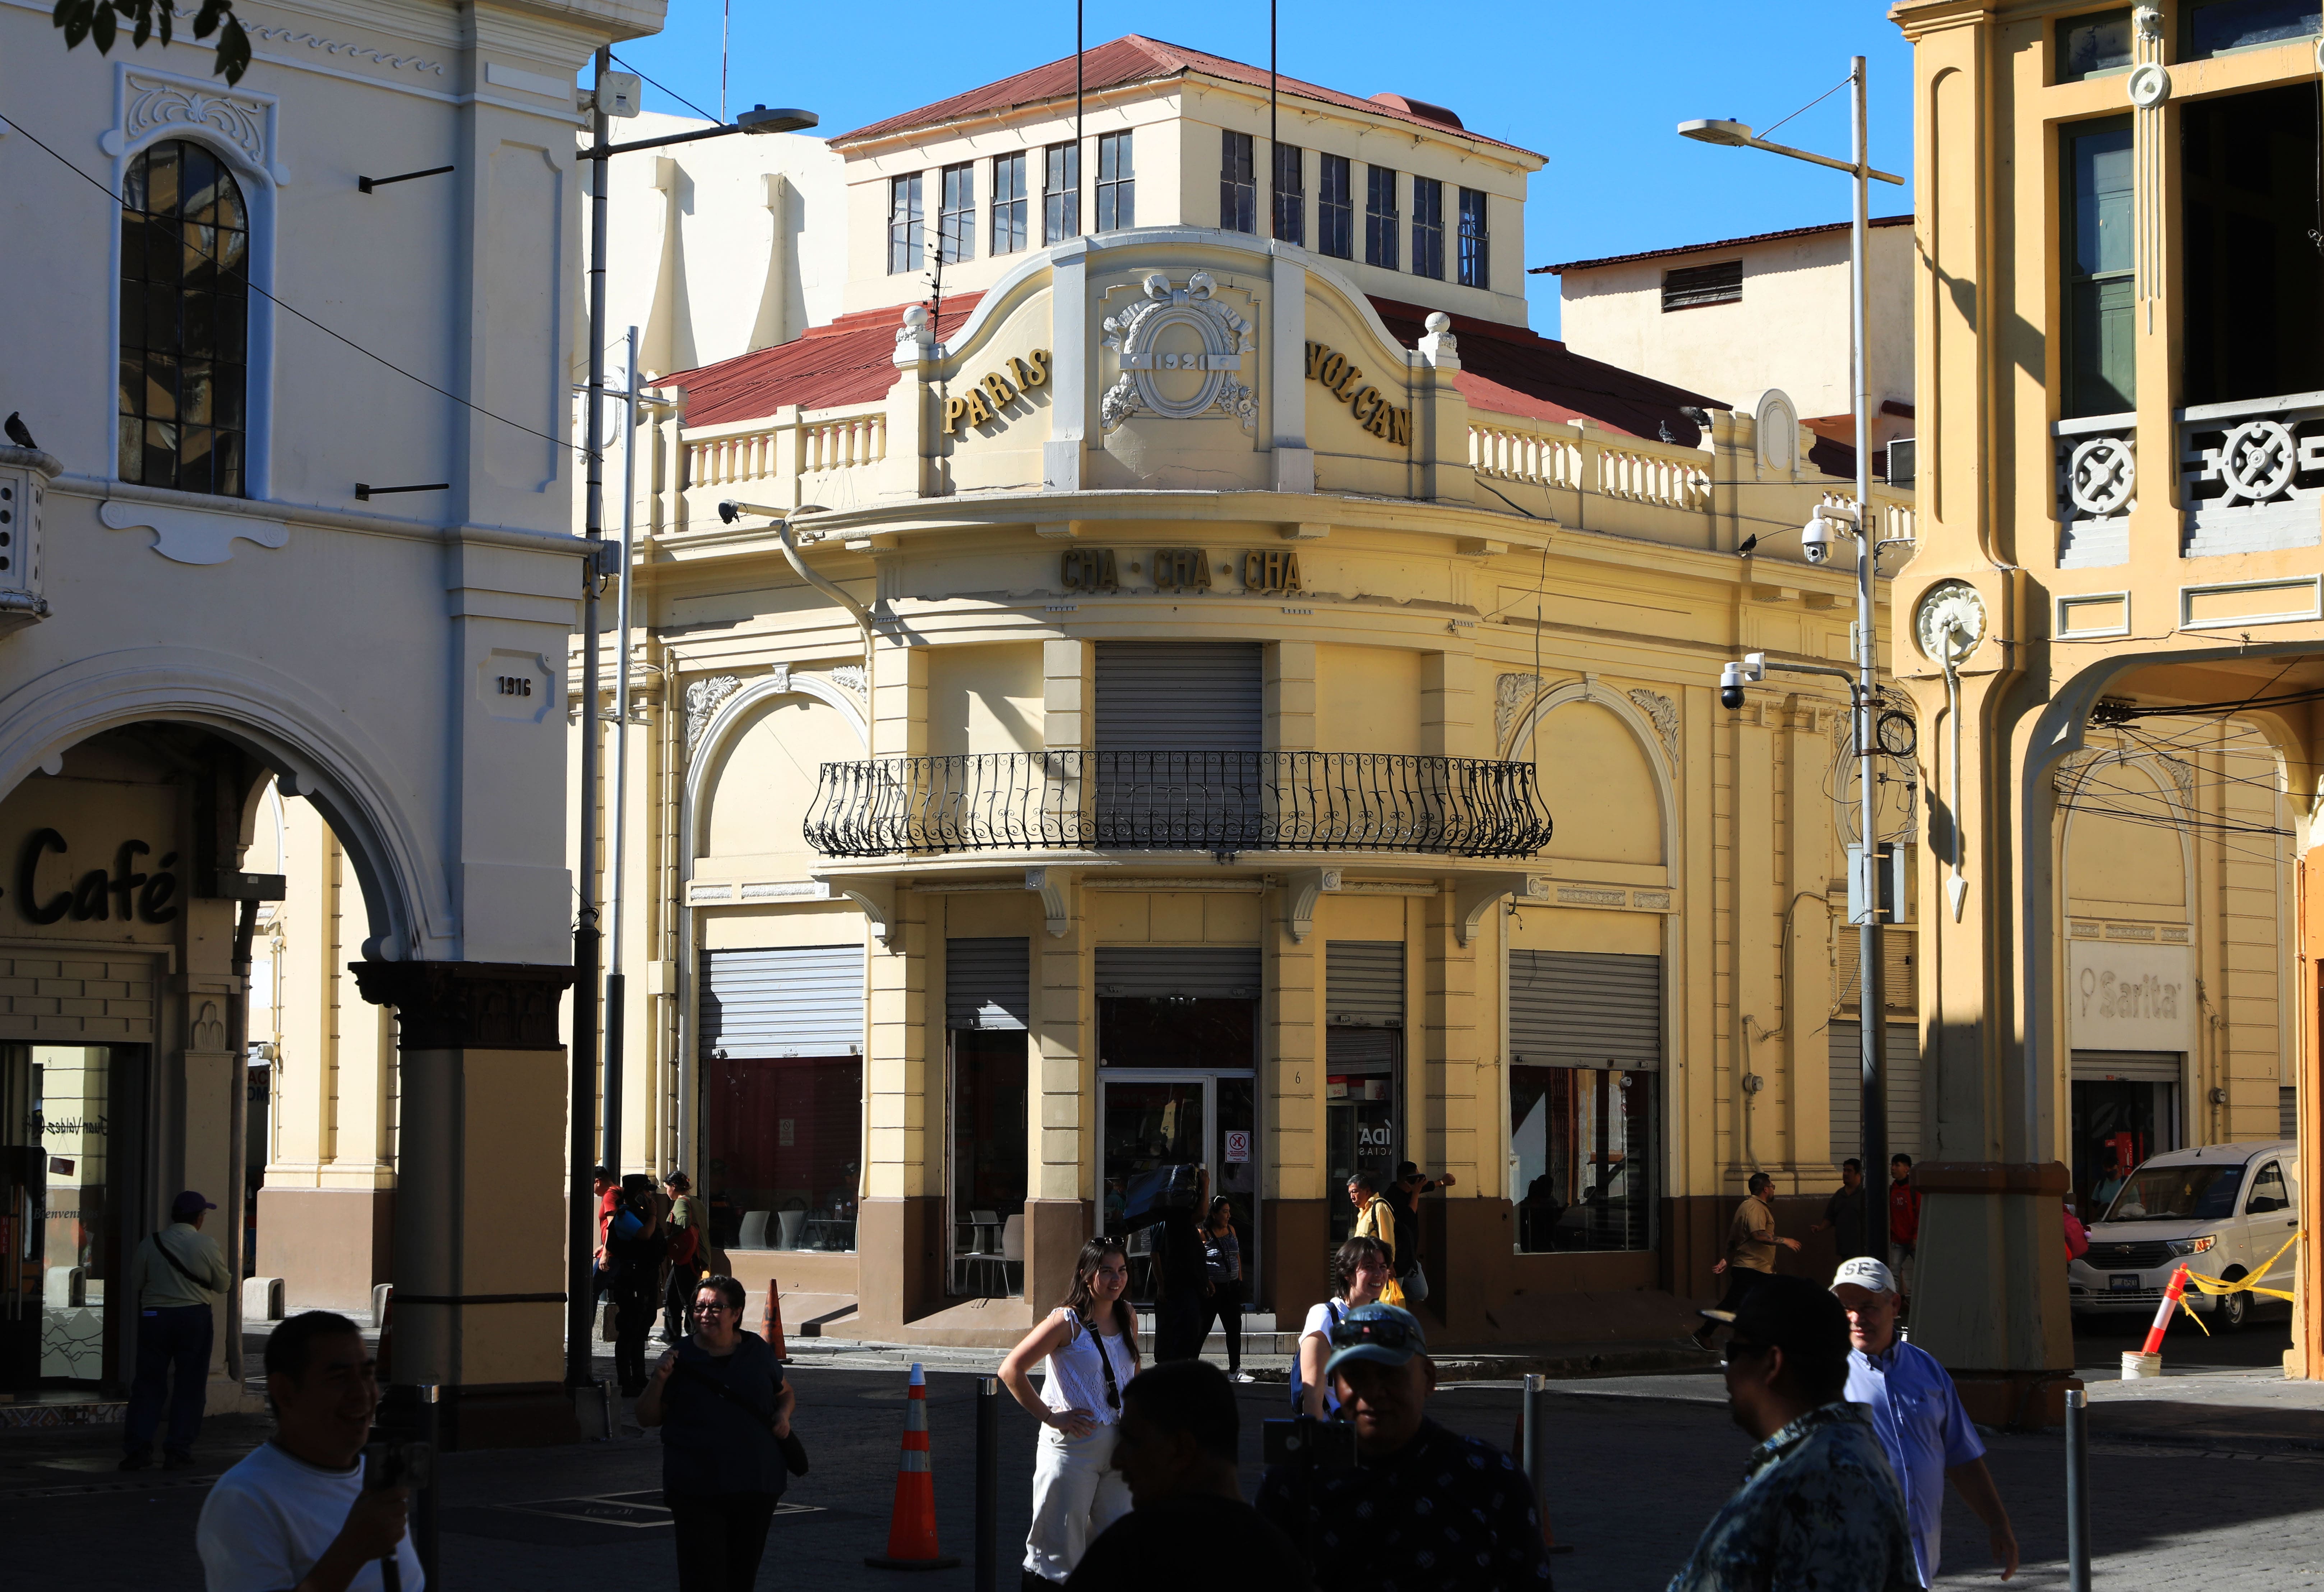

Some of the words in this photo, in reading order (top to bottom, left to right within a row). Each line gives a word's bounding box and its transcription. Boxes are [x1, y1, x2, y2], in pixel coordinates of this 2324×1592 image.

[1155, 353, 1206, 370] 1921
[943, 348, 1049, 435] PARIS
[1306, 340, 1412, 446] VOLCAN
[1061, 549, 1119, 588] CHA
[1153, 549, 1211, 587] CHA
[1244, 551, 1302, 590] CHA
[498, 676, 531, 696] 1916
[22, 827, 179, 924] Café
[2099, 971, 2177, 1019] Sarita
[1295, 1071, 1300, 1084] 6
[33, 1208, 98, 1219] Bienvenidos
